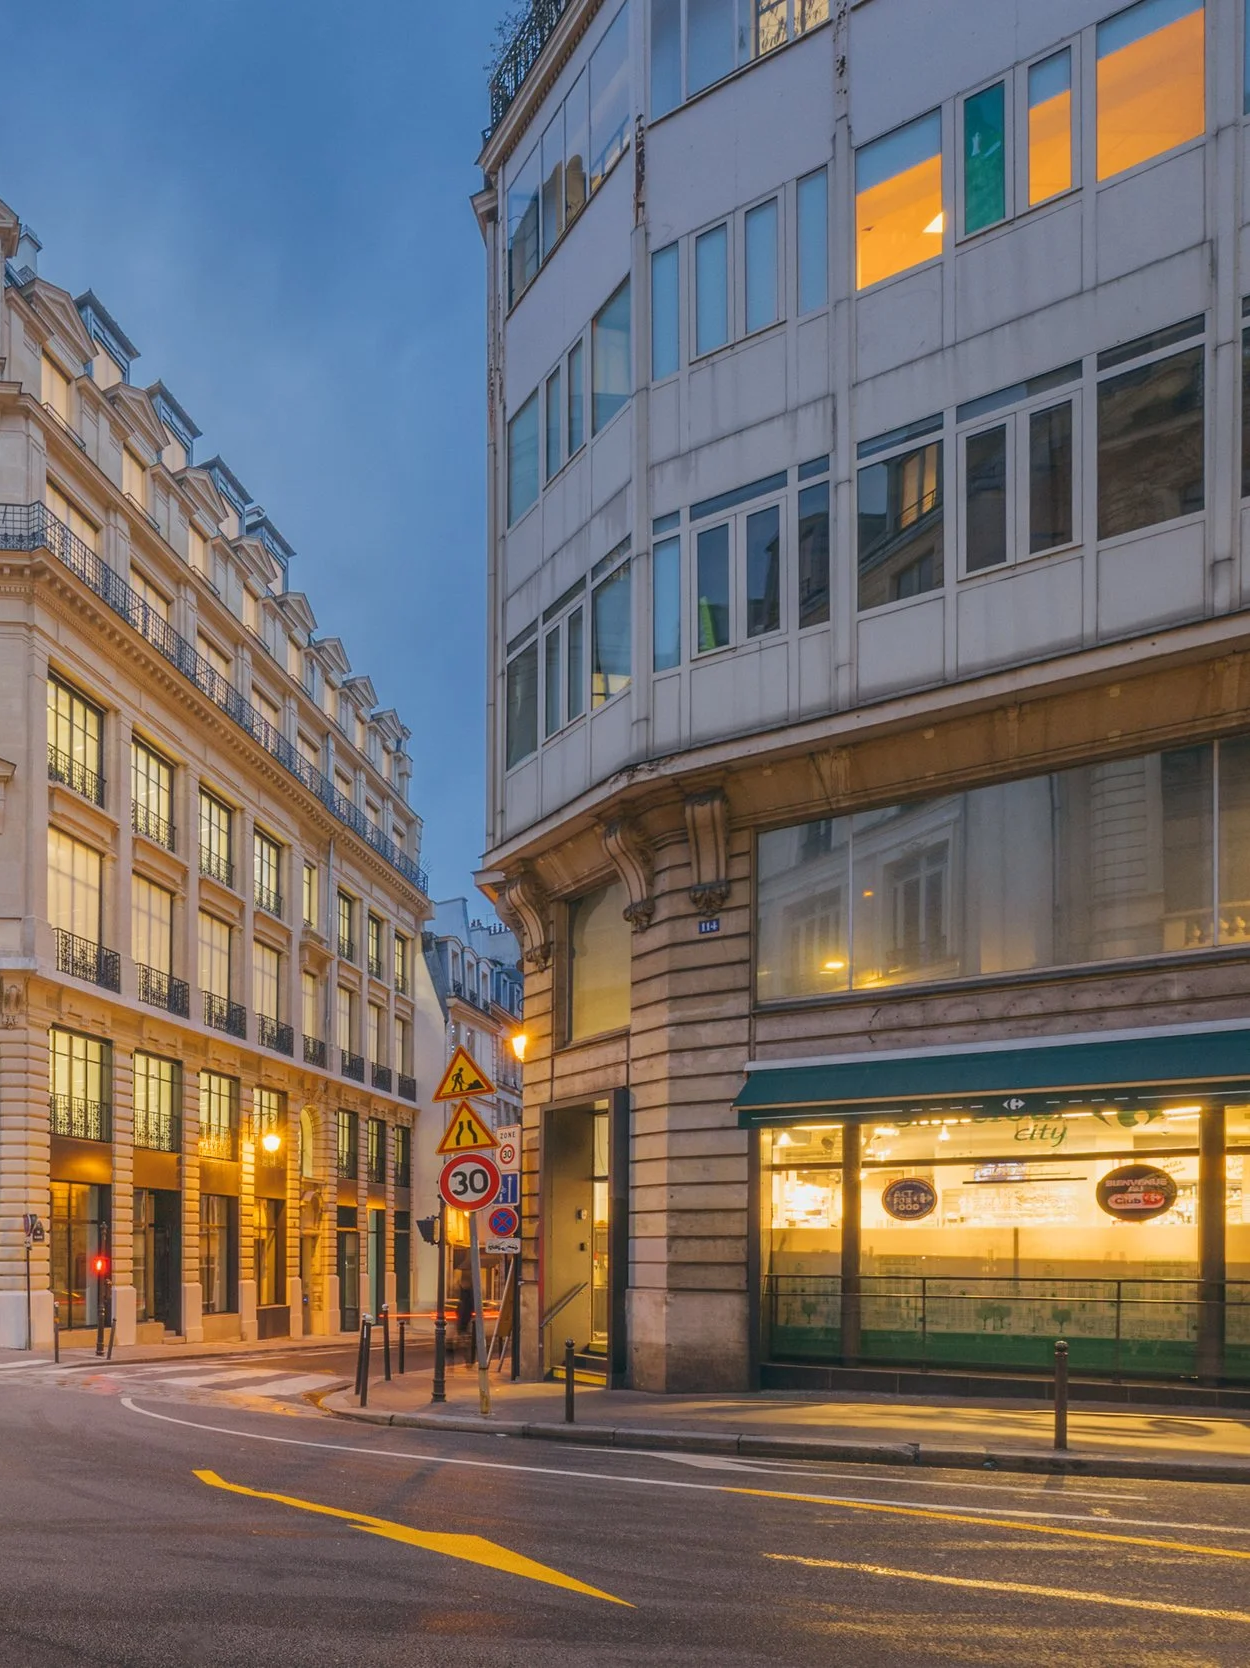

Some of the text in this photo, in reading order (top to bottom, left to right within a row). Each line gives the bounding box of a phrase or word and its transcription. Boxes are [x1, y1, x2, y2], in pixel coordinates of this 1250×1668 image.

[701, 921, 718, 932] 114
[500, 1131, 516, 1140] ZONE
[1013, 1125, 1068, 1148] city
[503, 1149, 512, 1159] 30
[451, 1168, 489, 1196] 30
[1105, 1178, 1168, 1187] BIENVENUE
[1115, 1197, 1141, 1205] Club
[893, 1203, 920, 1211] FOOD
